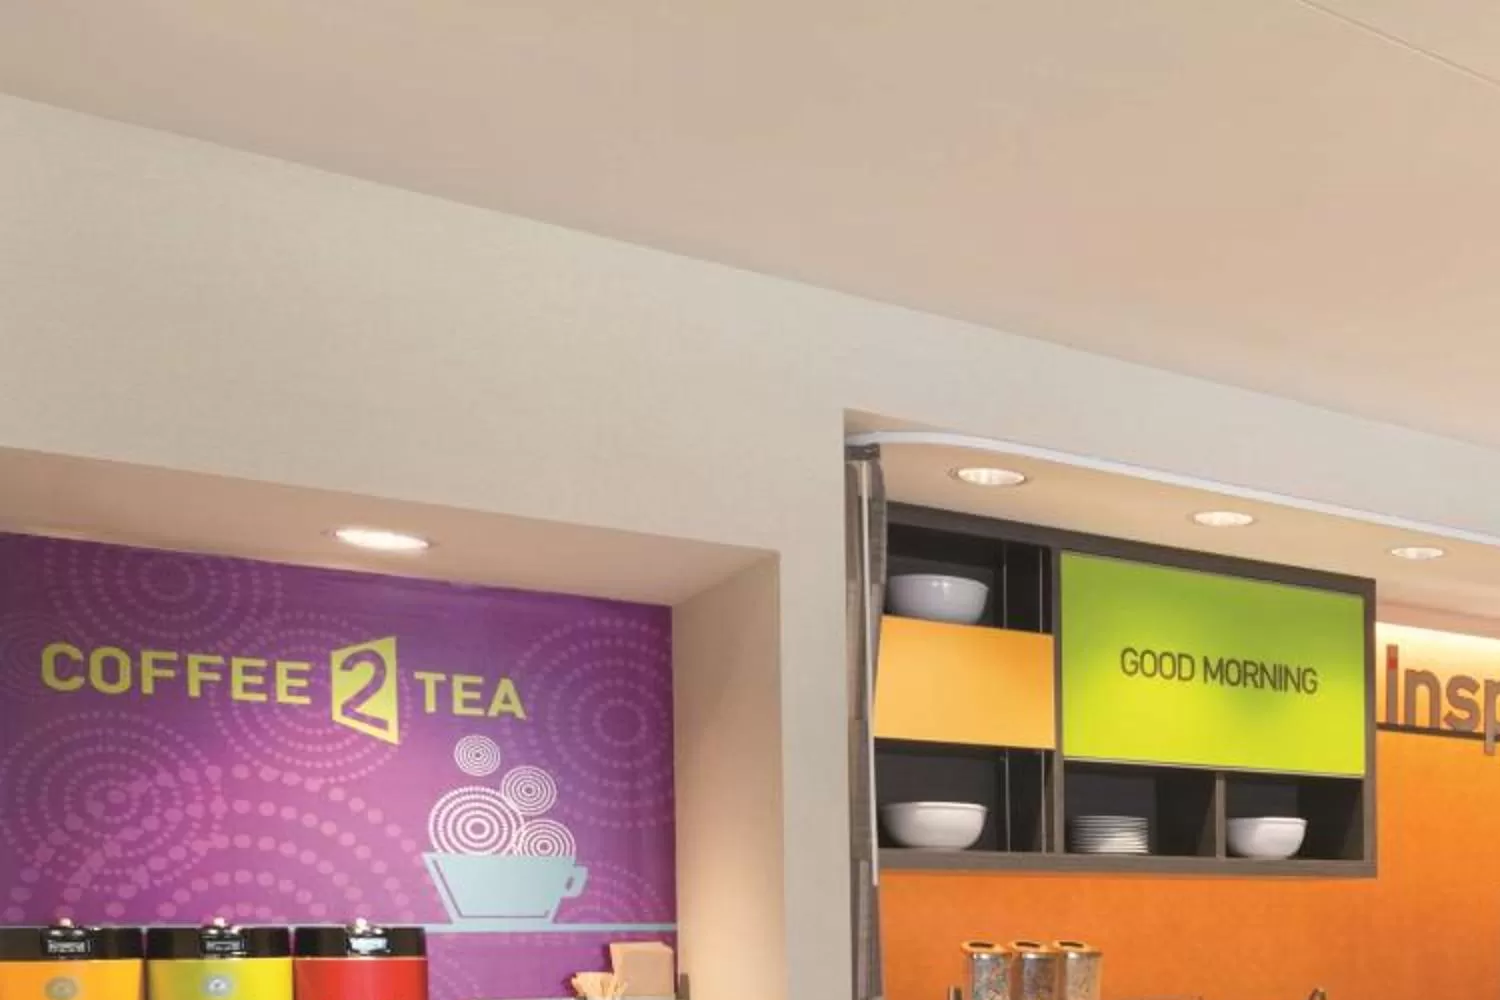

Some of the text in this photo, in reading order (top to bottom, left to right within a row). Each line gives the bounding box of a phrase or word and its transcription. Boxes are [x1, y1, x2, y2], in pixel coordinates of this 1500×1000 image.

[41, 642, 527, 734] COFFEE 2 TEA
[1120, 647, 1319, 695] GOOD MORNING
